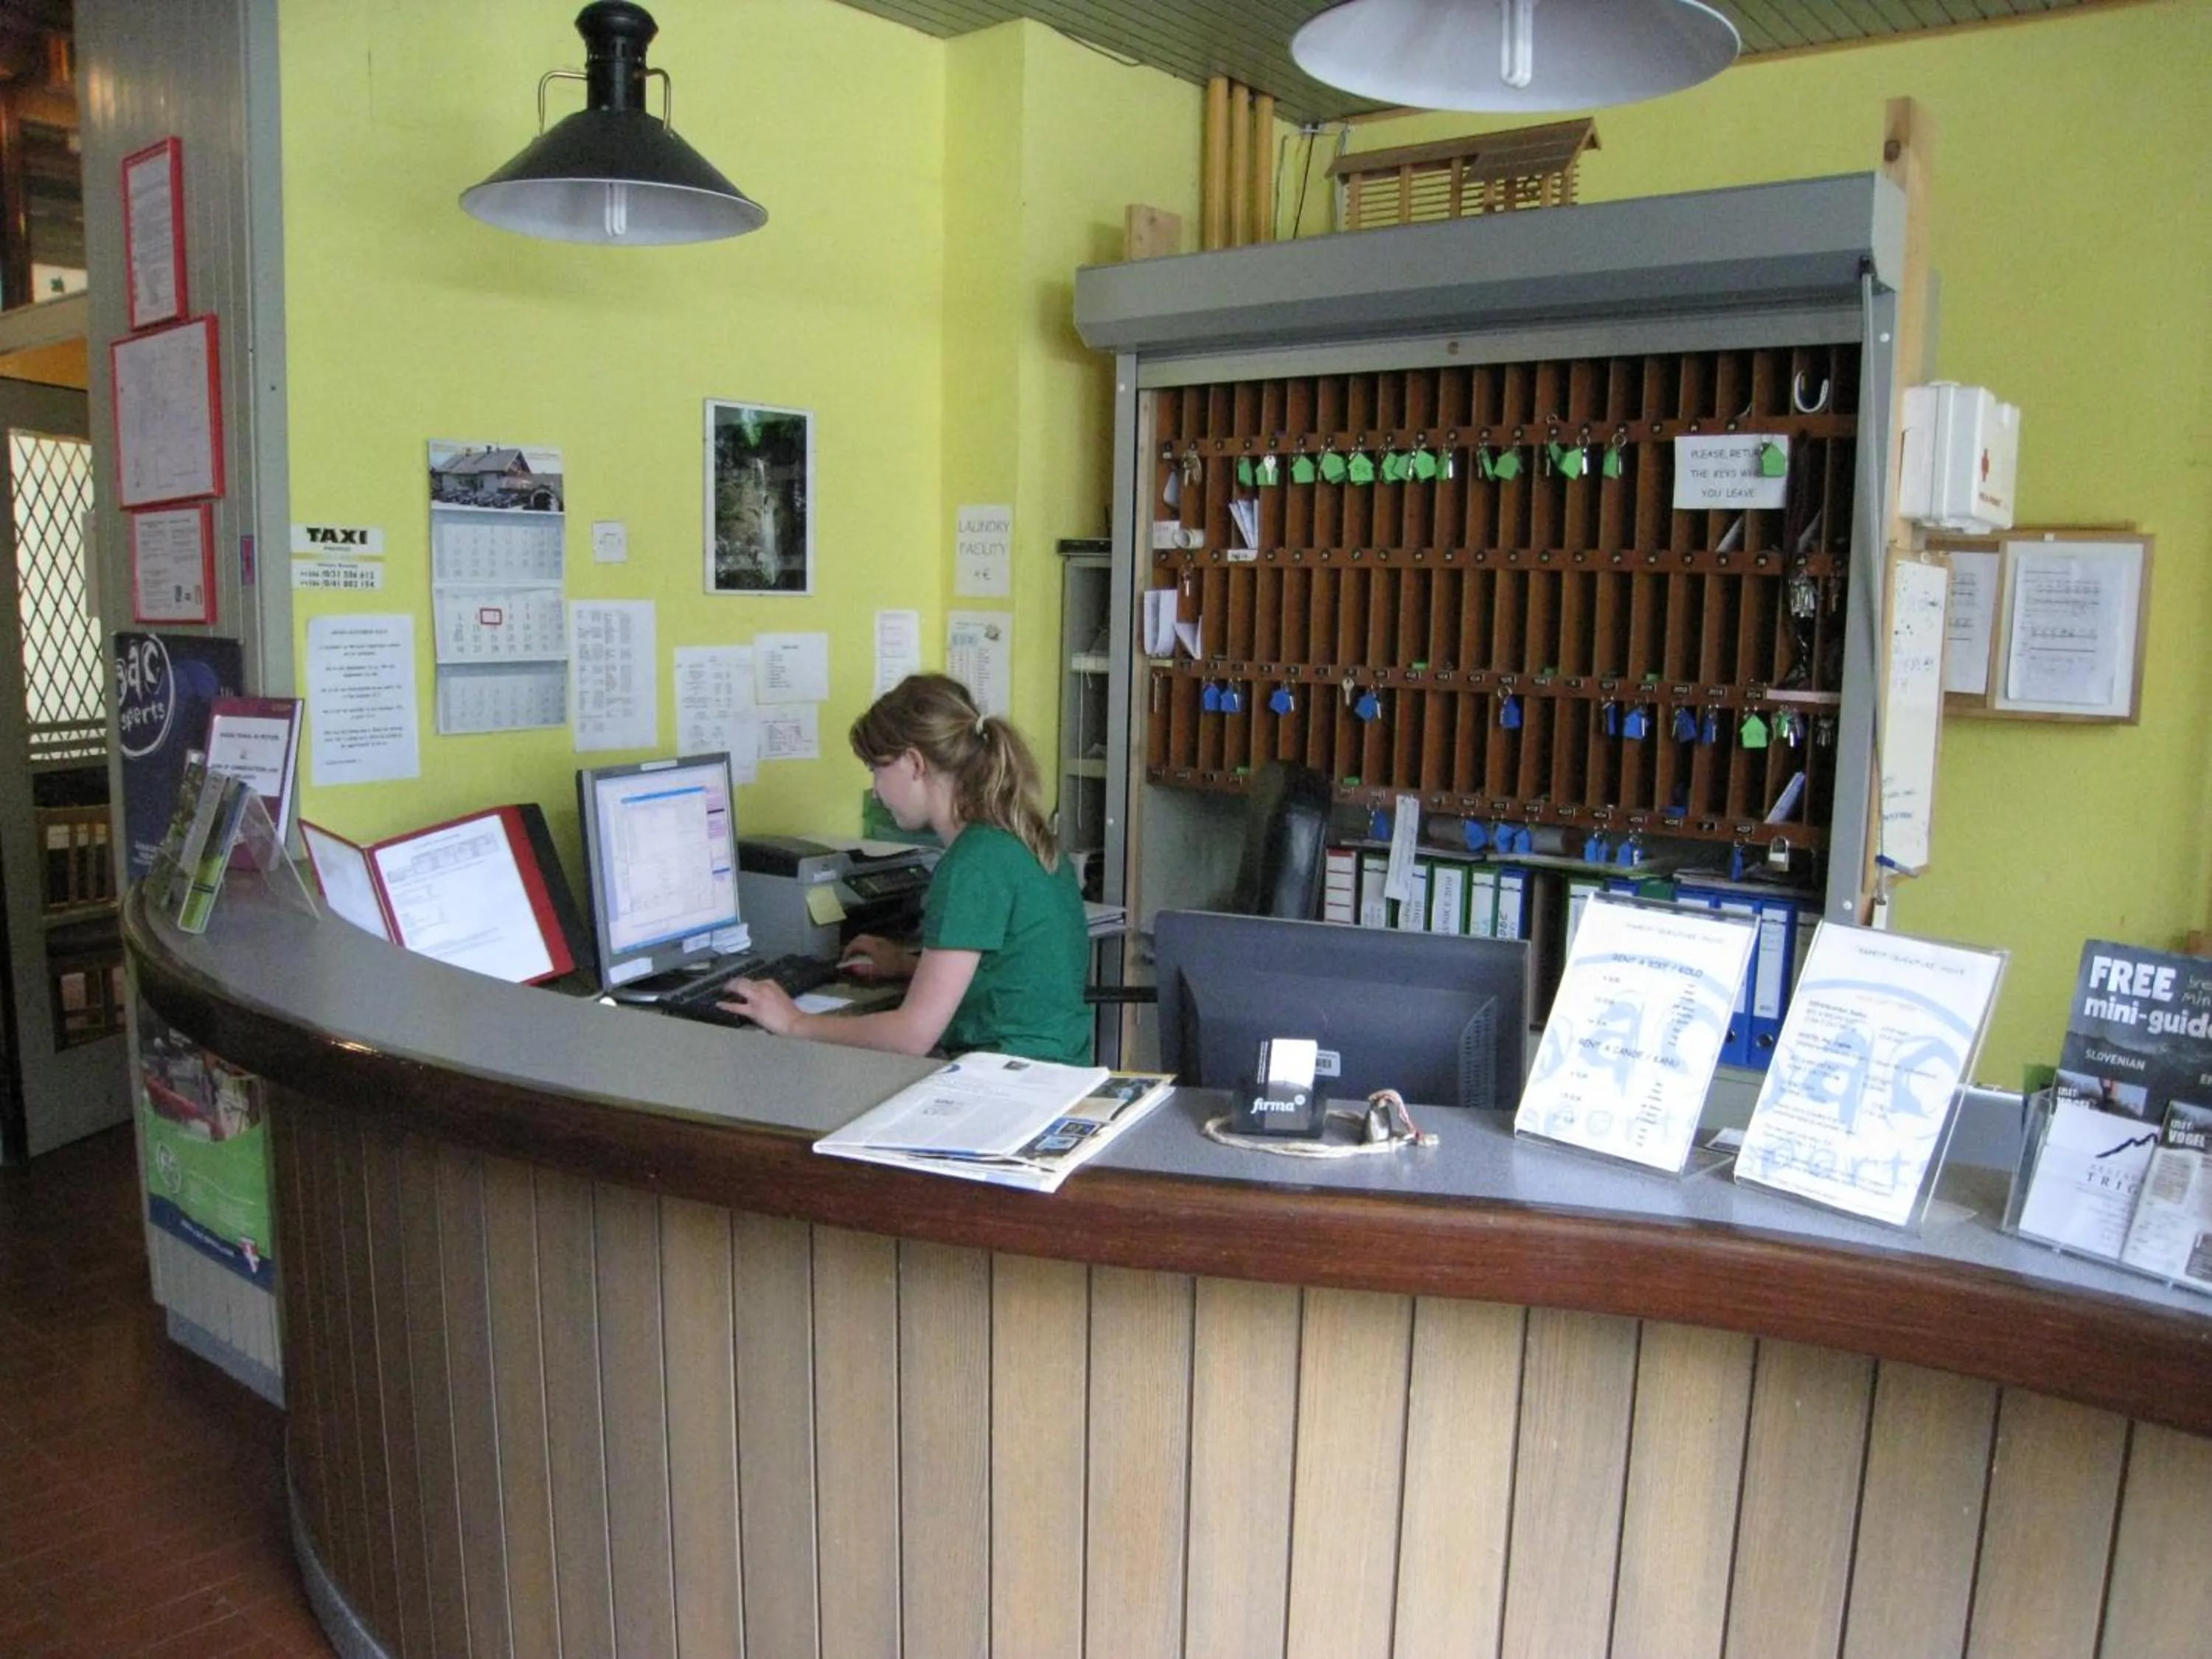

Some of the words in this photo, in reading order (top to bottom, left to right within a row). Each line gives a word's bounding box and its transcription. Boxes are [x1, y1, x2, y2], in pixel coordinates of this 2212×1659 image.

[1729, 448, 1762, 459] RETUR
[1691, 469, 1708, 478] THE
[1701, 488, 1722, 498] YOU
[1725, 488, 1756, 498] LEAVE
[306, 526, 368, 545] TAXI
[2089, 955, 2177, 1002] FREE
[2084, 996, 2212, 1039] mini-guid
[2084, 1048, 2146, 1071] SLOVENIAN
[1250, 1096, 1295, 1115] firma
[2168, 1128, 2205, 1148] VOGEL
